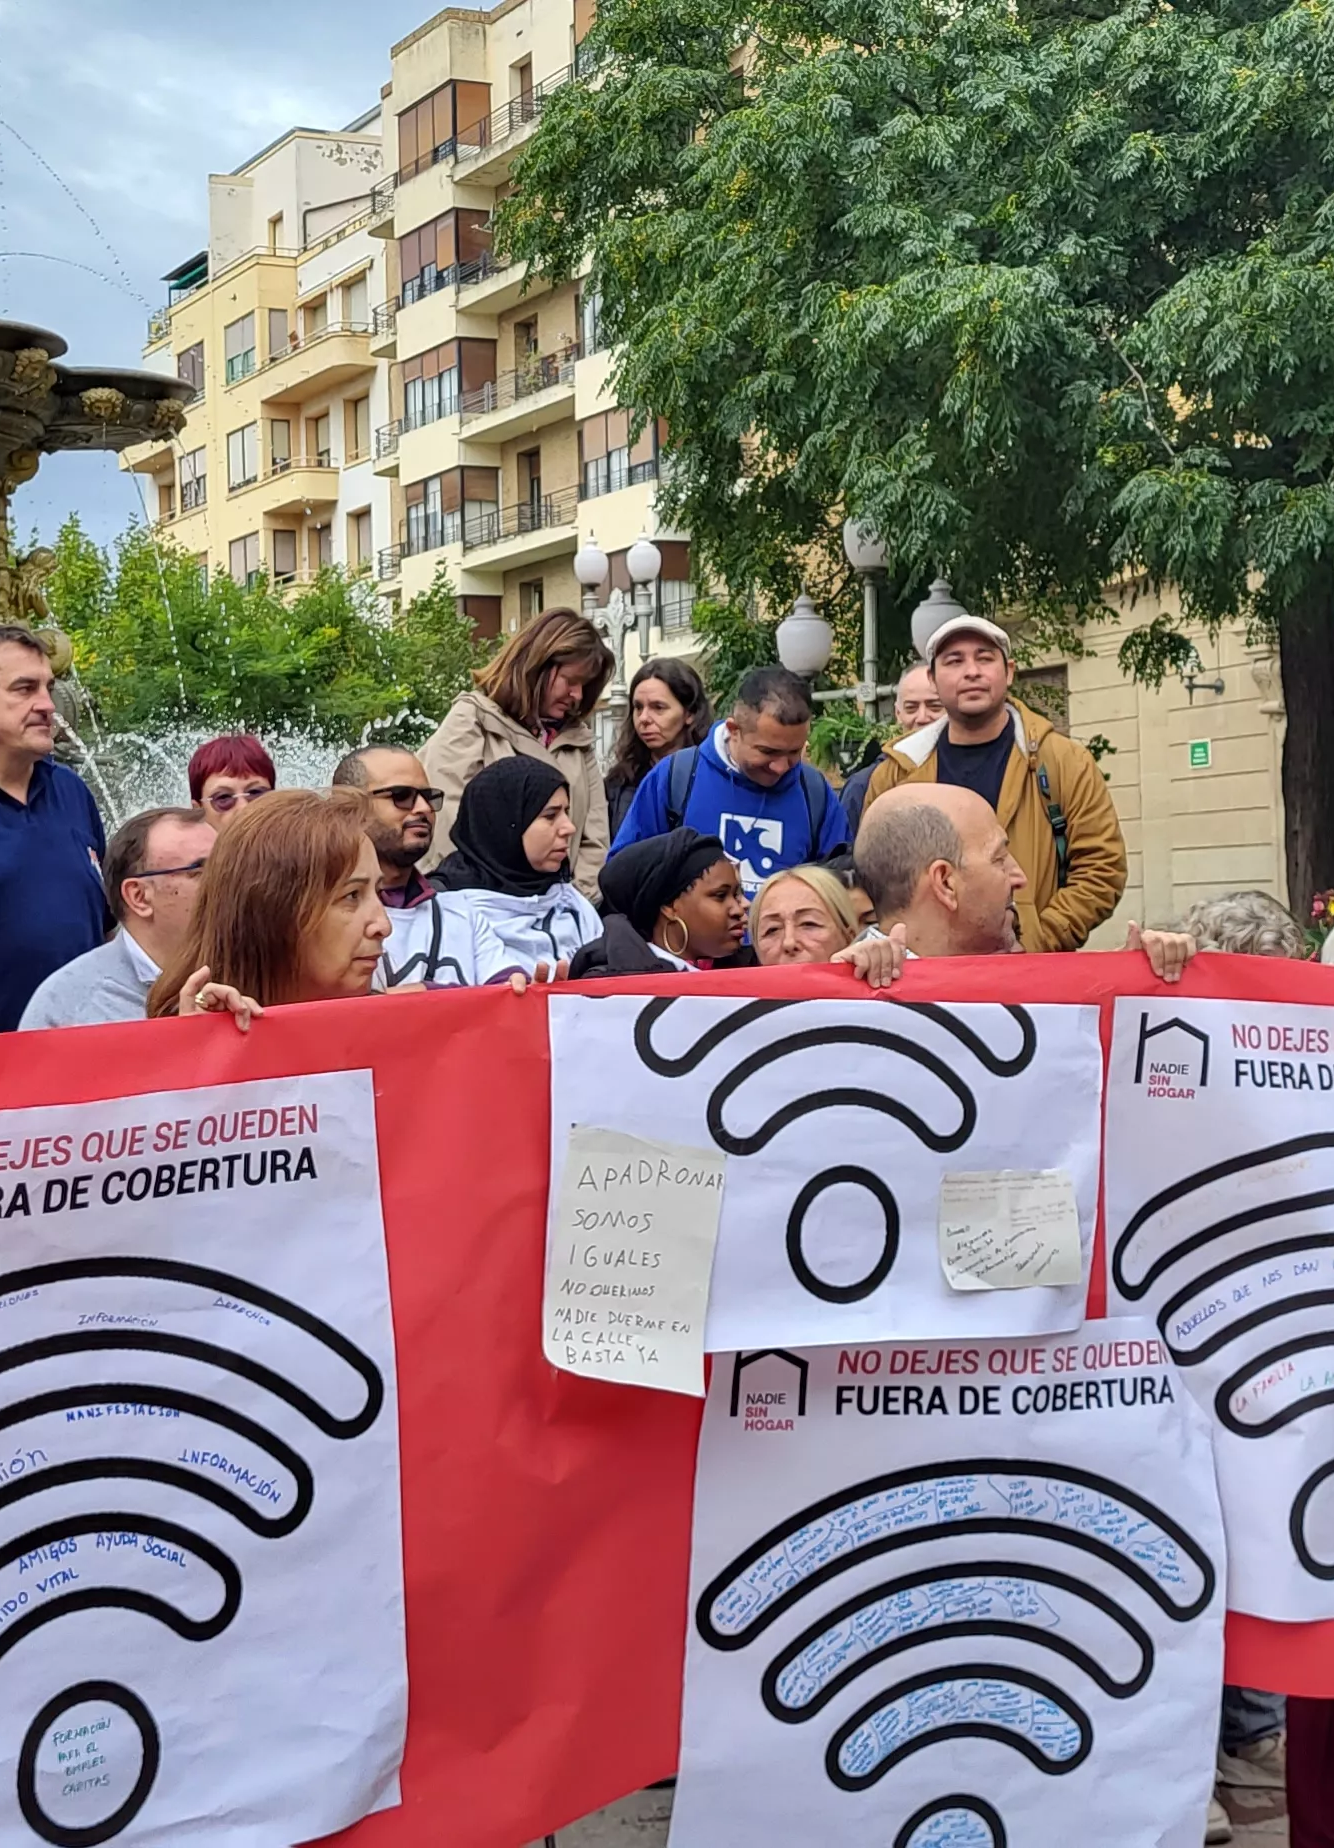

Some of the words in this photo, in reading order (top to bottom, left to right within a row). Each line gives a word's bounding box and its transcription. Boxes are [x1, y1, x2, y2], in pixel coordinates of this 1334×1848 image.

[1232, 1024, 1262, 1050] NO
[1267, 1026, 1329, 1054] DEJES
[1148, 1074, 1171, 1086] SIN
[1149, 1062, 1190, 1076] NADIE
[1235, 1059, 1315, 1091] FUERA
[1147, 1086, 1196, 1100] HOGAR
[81, 1125, 148, 1163] QUE
[152, 1119, 192, 1153] SE
[197, 1103, 319, 1147] QUEDEN
[42, 1174, 94, 1214] DE
[101, 1146, 318, 1206] COBERTURA
[577, 1159, 724, 1192] APADRONAR
[571, 1208, 654, 1234] SOMOS
[560, 1278, 587, 1296] NO
[1232, 1284, 1253, 1303] QUE
[1262, 1269, 1283, 1288] NOS
[1293, 1259, 1320, 1277] DAN
[554, 1307, 598, 1325] NADIE
[607, 1311, 666, 1331] DUERME
[671, 1320, 691, 1334] EN
[551, 1327, 574, 1342] LA
[581, 1331, 634, 1347] CALLE
[565, 1345, 626, 1365] BASTA
[636, 1344, 660, 1365] YA
[837, 1349, 882, 1375] NO
[889, 1348, 980, 1375] DEJES
[987, 1348, 1046, 1377] QUE
[1051, 1346, 1079, 1373] SE
[746, 1392, 787, 1406] NADIE
[835, 1385, 949, 1416] FUERA
[959, 1385, 1001, 1416] DE
[1011, 1375, 1176, 1416] COBERTURA
[745, 1406, 769, 1418] SIN
[744, 1419, 795, 1432] HOGAR
[178, 1448, 283, 1502] INFORMACIÓN
[18, 1536, 78, 1575] AMIGOS
[96, 1533, 139, 1551] AYUDA
[142, 1536, 188, 1568] SOCIAL
[36, 1569, 80, 1594] VITAL
